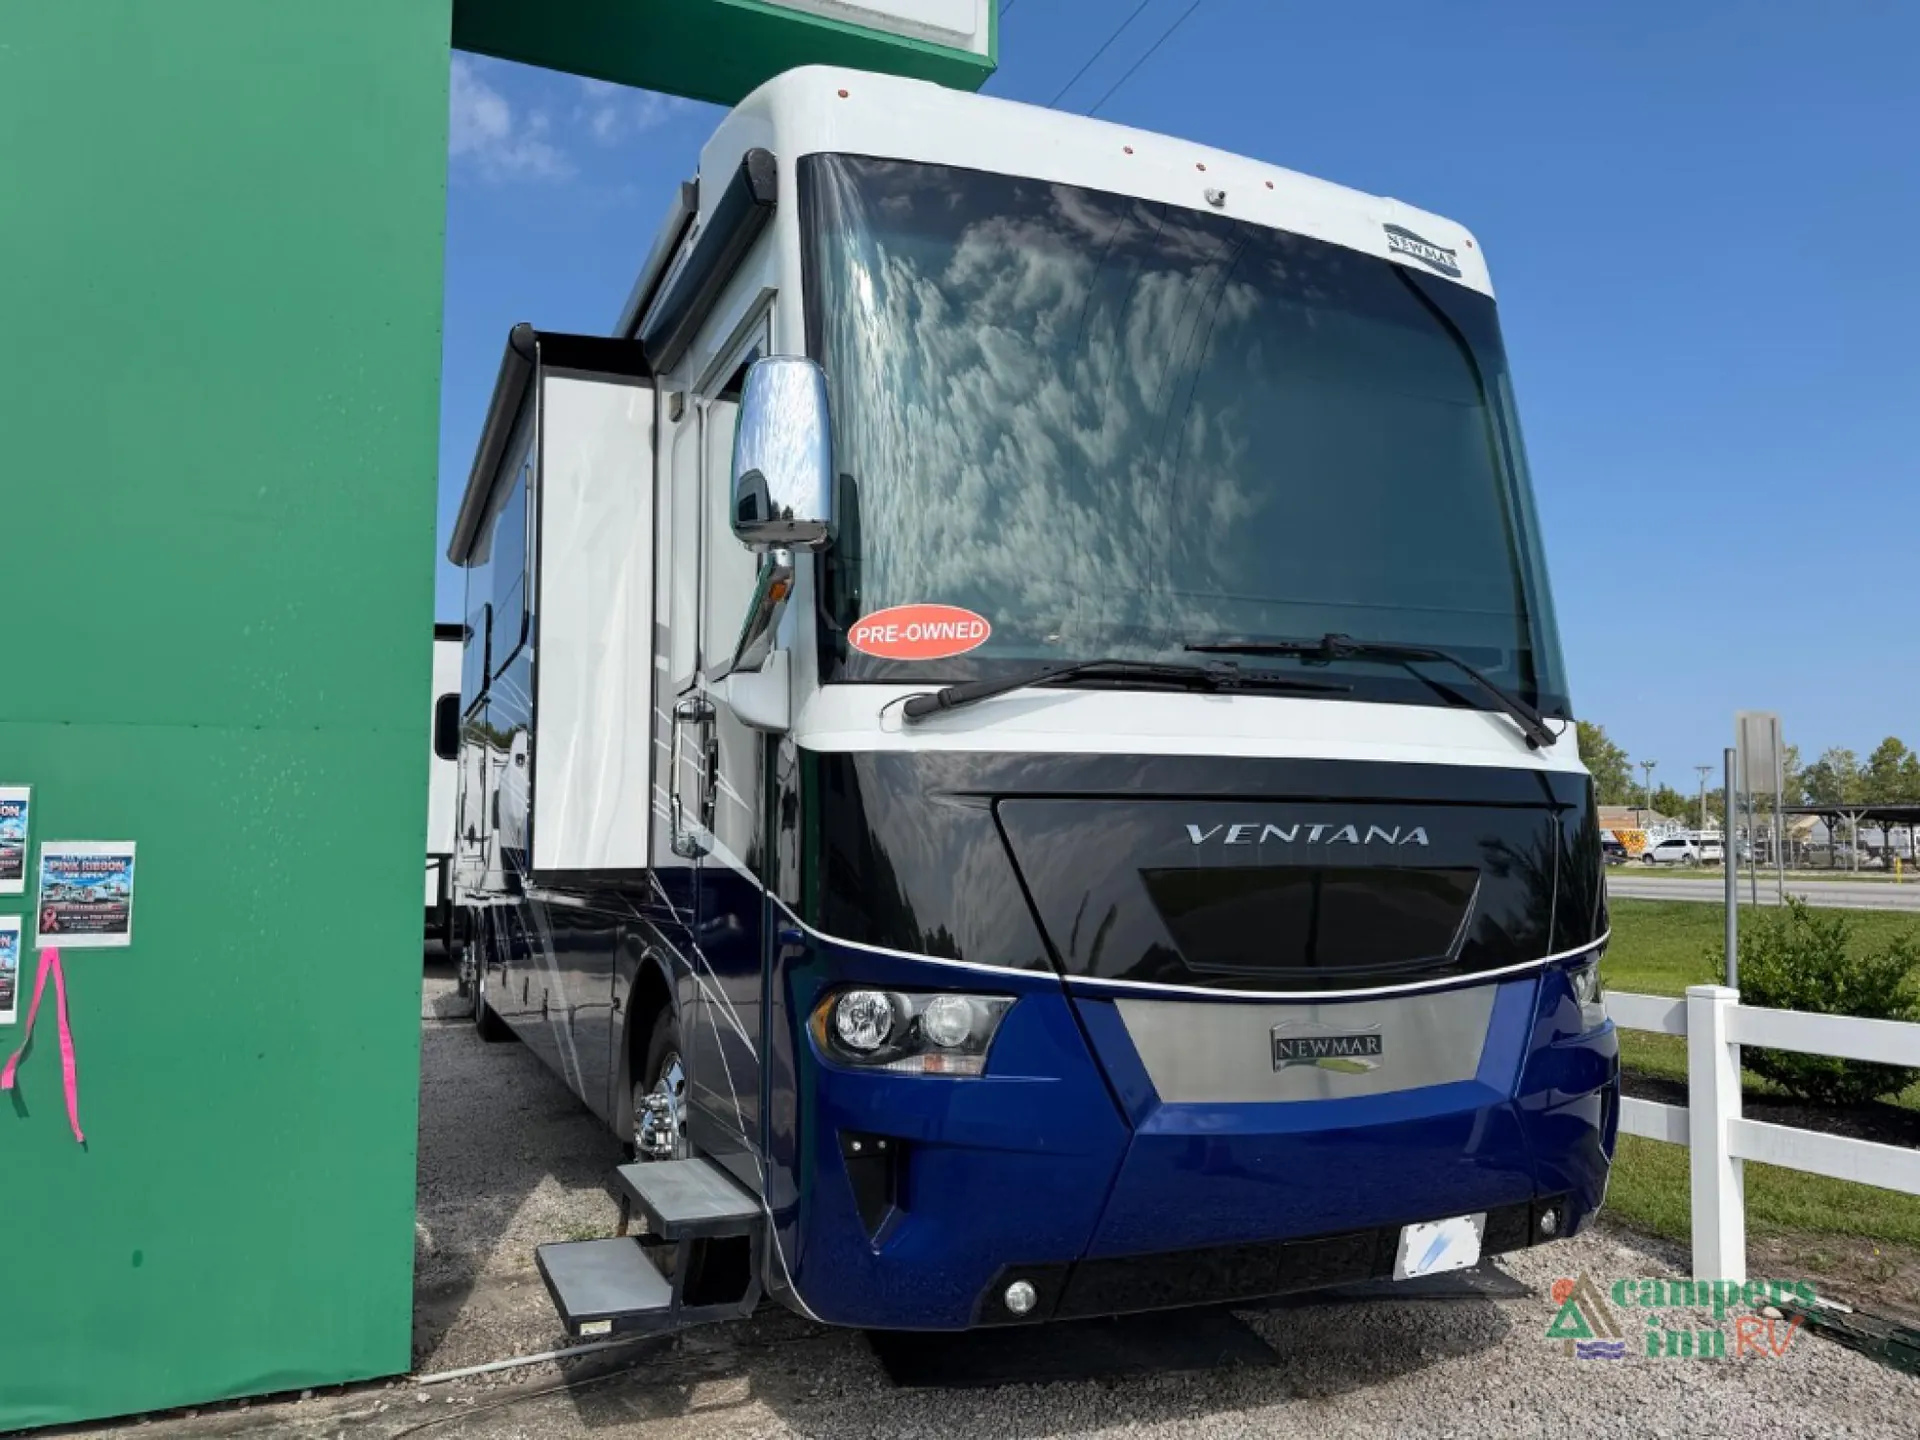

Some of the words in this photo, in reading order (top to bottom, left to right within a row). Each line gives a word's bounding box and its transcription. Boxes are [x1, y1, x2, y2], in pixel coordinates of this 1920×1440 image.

[1386, 233, 1458, 268] NEWMAR
[855, 621, 983, 645] PRE-OWNED
[1184, 823, 1430, 846] VENTANA
[48, 861, 79, 873] PINK
[82, 860, 125, 872] RIBBON
[1278, 1036, 1380, 1058] NEWMAR
